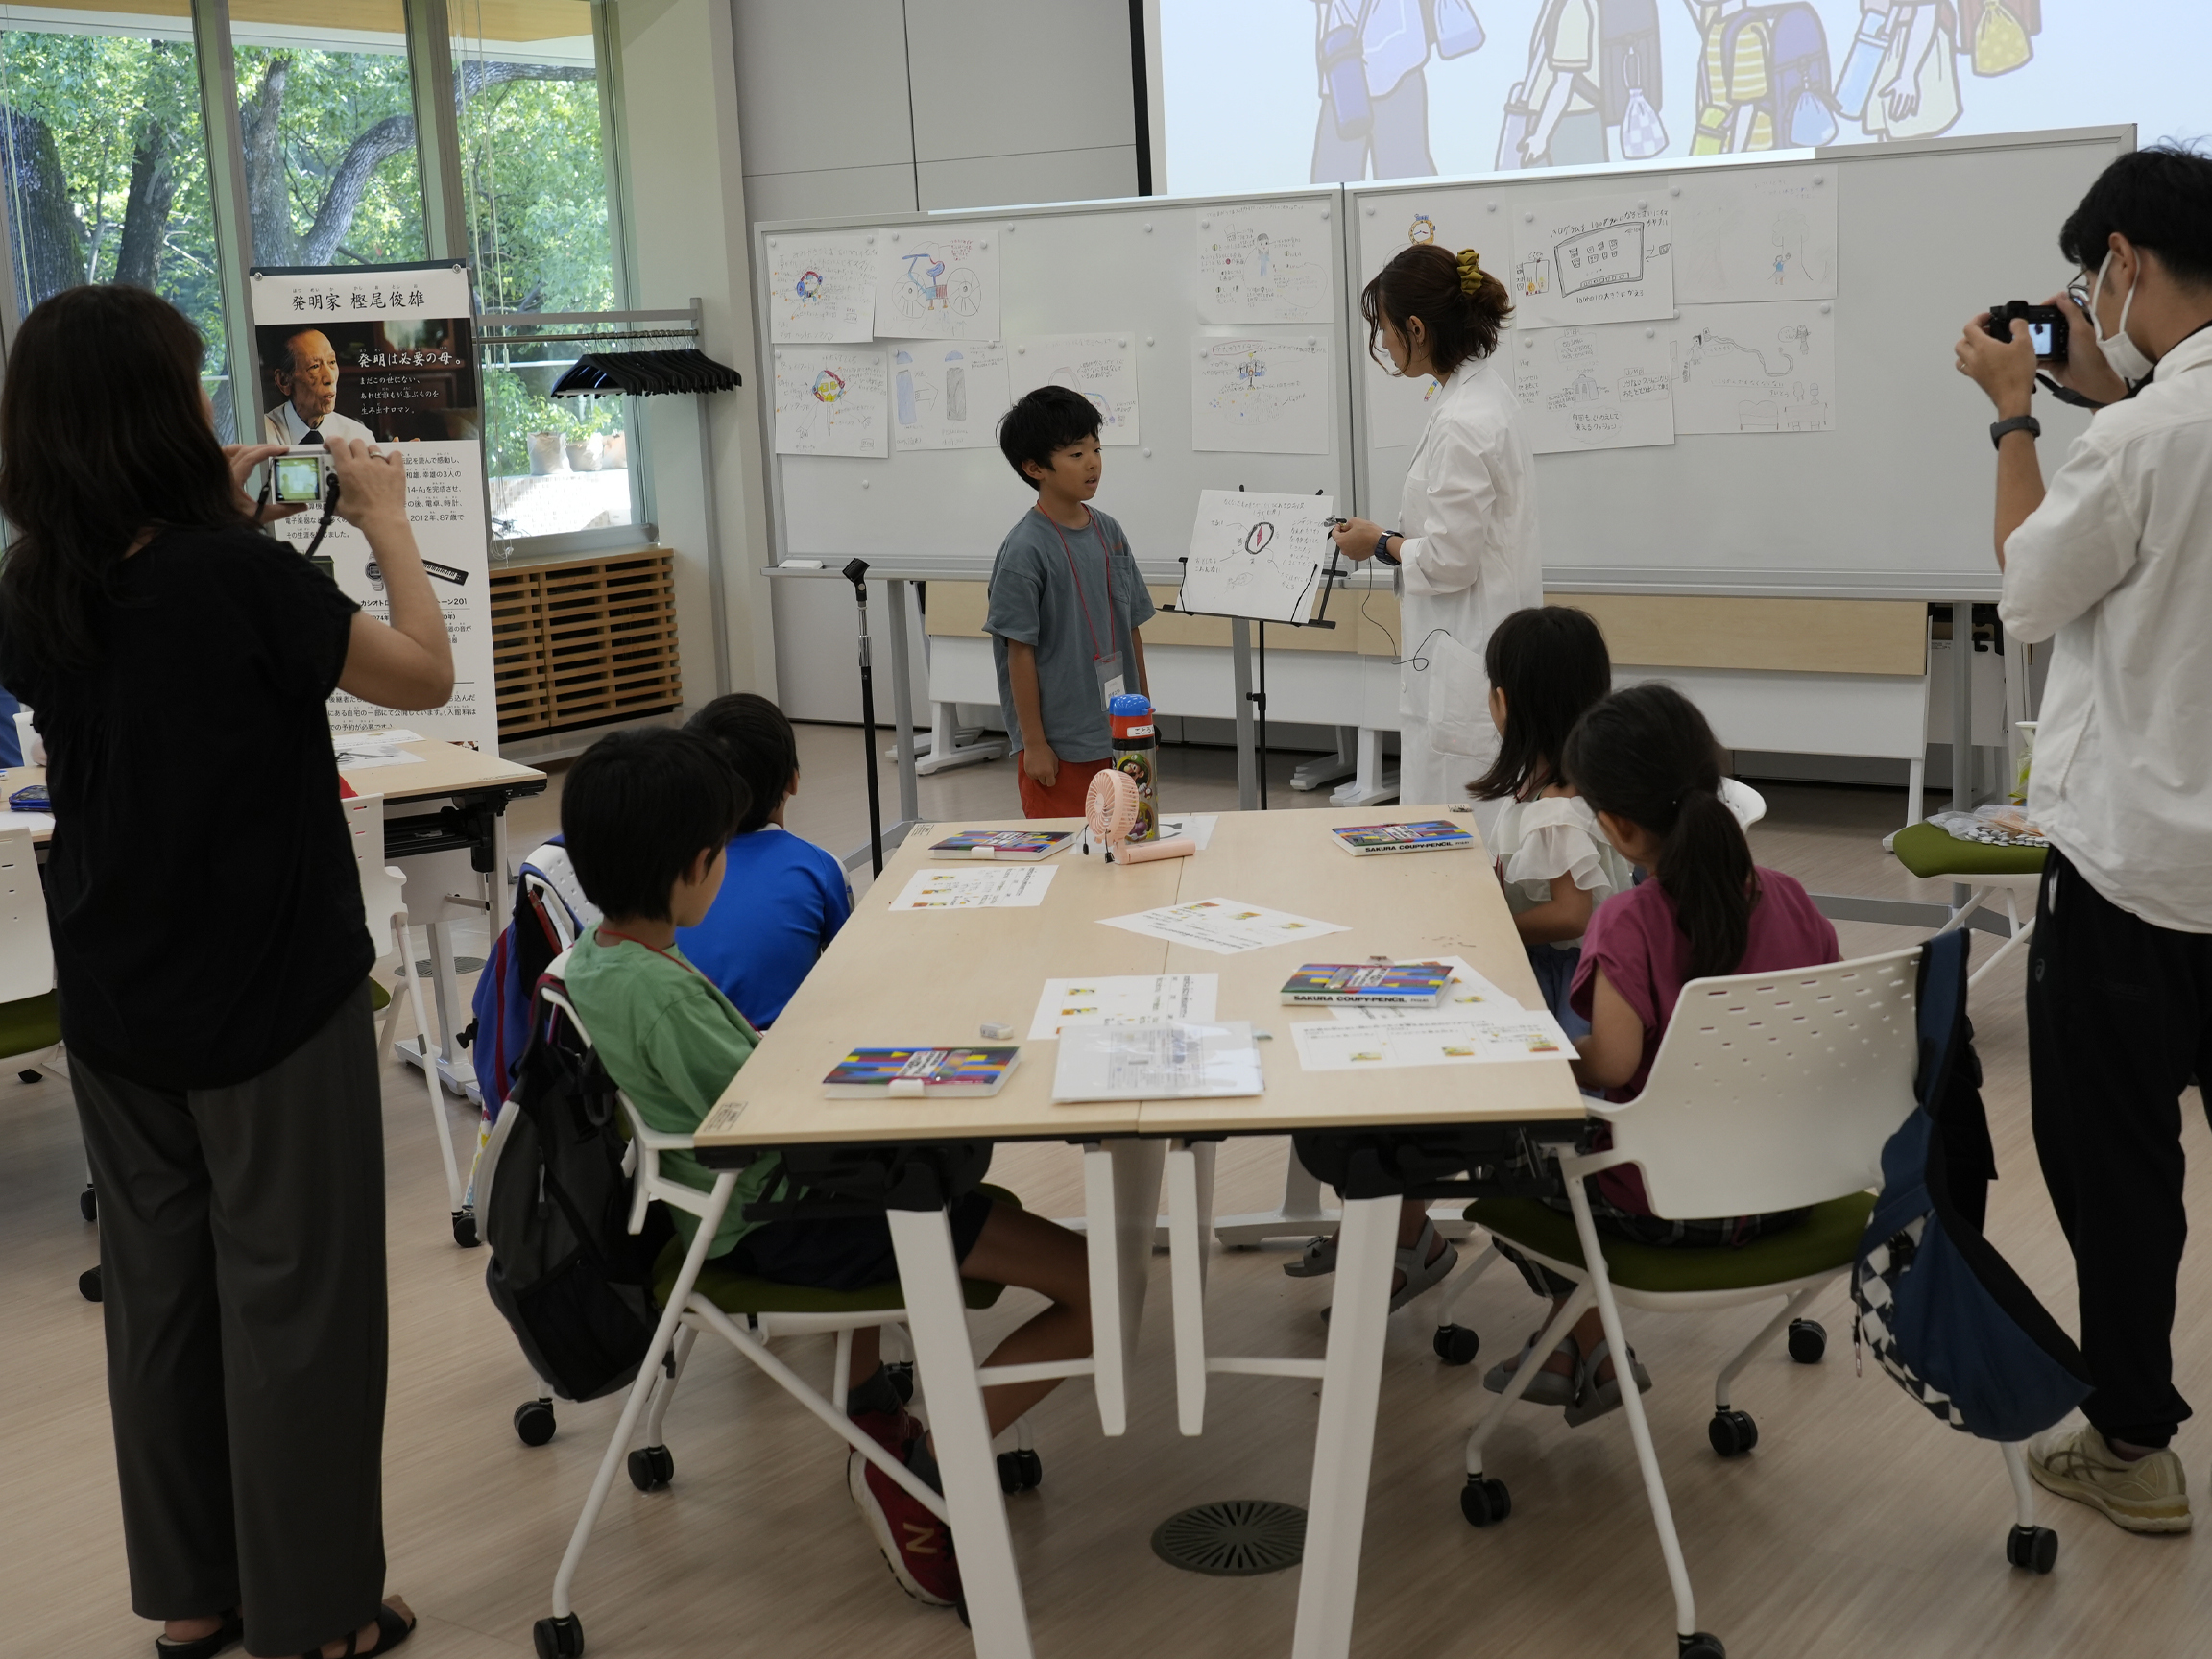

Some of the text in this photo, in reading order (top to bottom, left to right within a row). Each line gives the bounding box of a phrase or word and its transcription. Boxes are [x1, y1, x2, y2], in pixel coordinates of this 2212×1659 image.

[292, 290, 425, 311] 発明家 樫尾俊雄
[358, 351, 461, 367] 発明は必要の母。
[360, 375, 421, 385] まだこの世にない、
[360, 389, 439, 399] あれば誰もが喜ぶものを
[361, 406, 415, 416] 生み出すロマン。
[1399, 841, 1454, 850] COUPY-PENCIL
